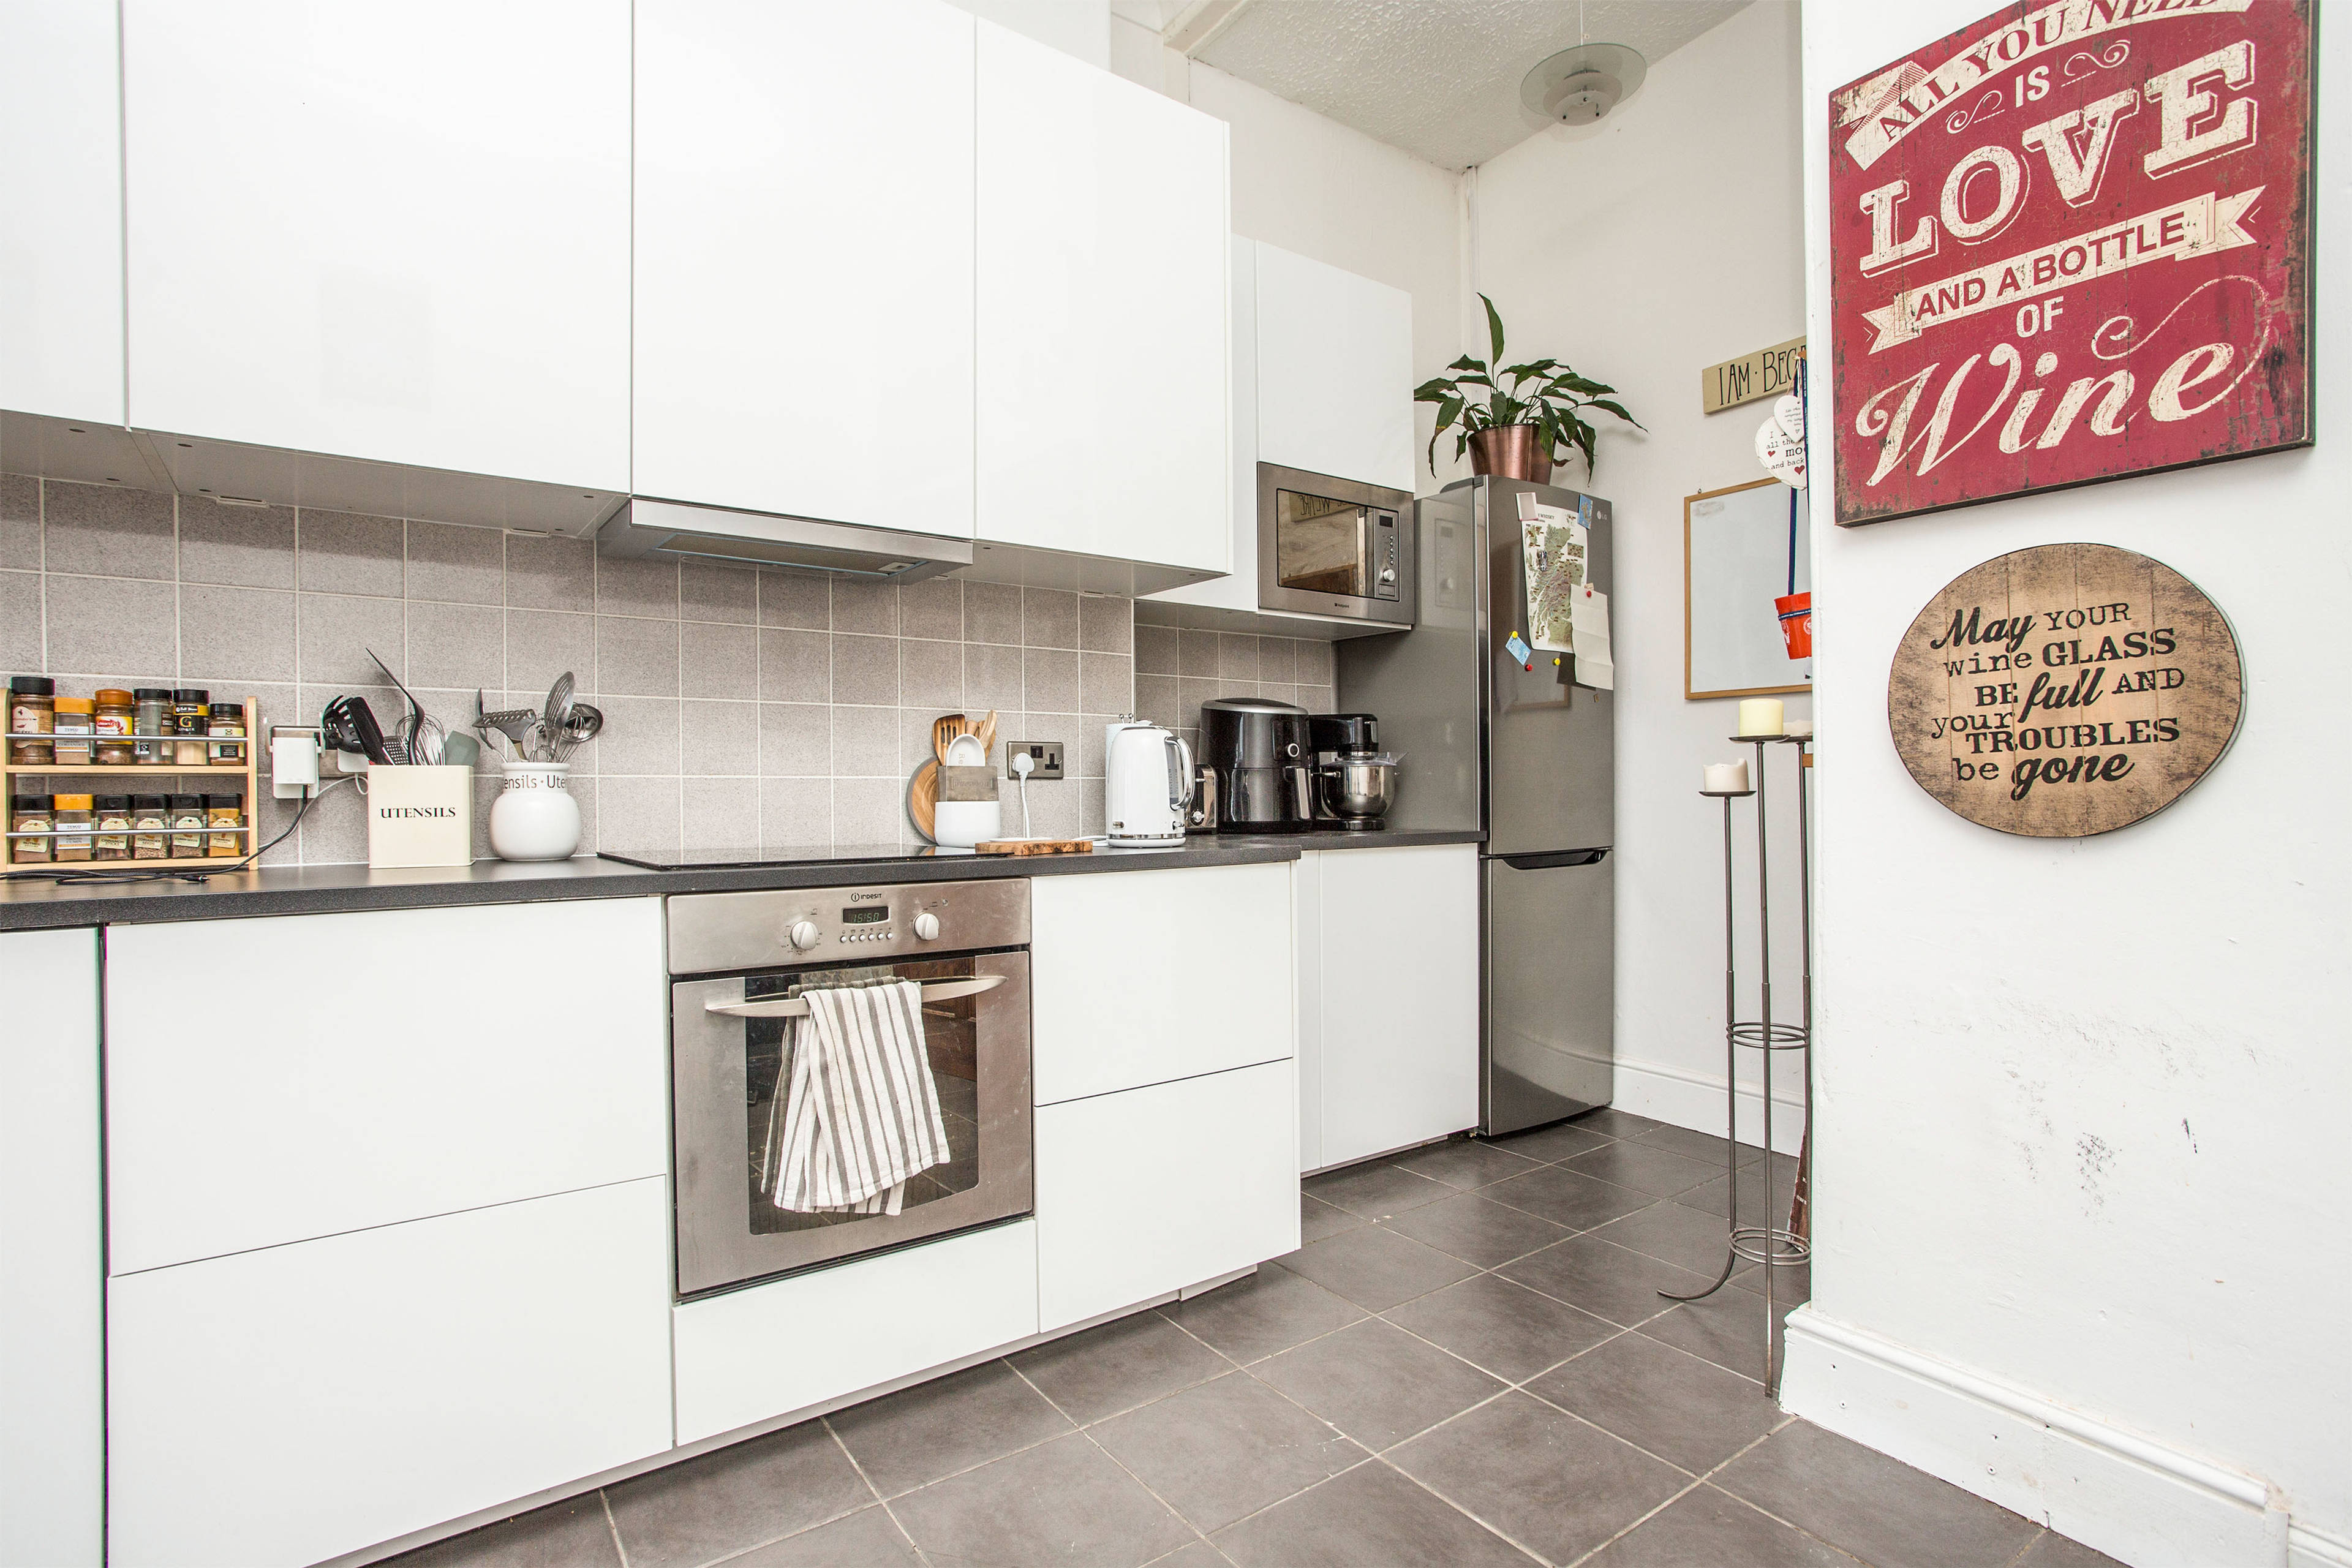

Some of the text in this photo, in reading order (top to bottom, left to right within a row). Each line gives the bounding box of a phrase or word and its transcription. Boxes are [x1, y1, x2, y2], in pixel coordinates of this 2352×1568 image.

[1879, 76, 1961, 143] ALL
[1961, 7, 2070, 77] YOU
[2015, 65, 2050, 108] IS
[1859, 39, 2258, 276] LOVE
[1915, 211, 2187, 322] AND A BOTTLE
[2016, 295, 2064, 339] OF
[1719, 367, 1724, 405] I
[1727, 362, 1750, 404] AM
[1856, 334, 2257, 487] Wine
[1766, 440, 1779, 450] all
[1771, 456, 1805, 470] and back
[1785, 447, 1804, 458] mo
[1929, 603, 2132, 653] May YOUR
[1943, 628, 2177, 677] wine GLASS
[1974, 667, 2185, 723] BE full AND
[179, 715, 192, 728] G
[1931, 710, 2015, 739] your
[1966, 718, 2180, 754] TROUBLES
[503, 774, 567, 789] ensils Ute
[1952, 753, 2135, 801] be gone
[380, 807, 456, 819] UTENSILS
